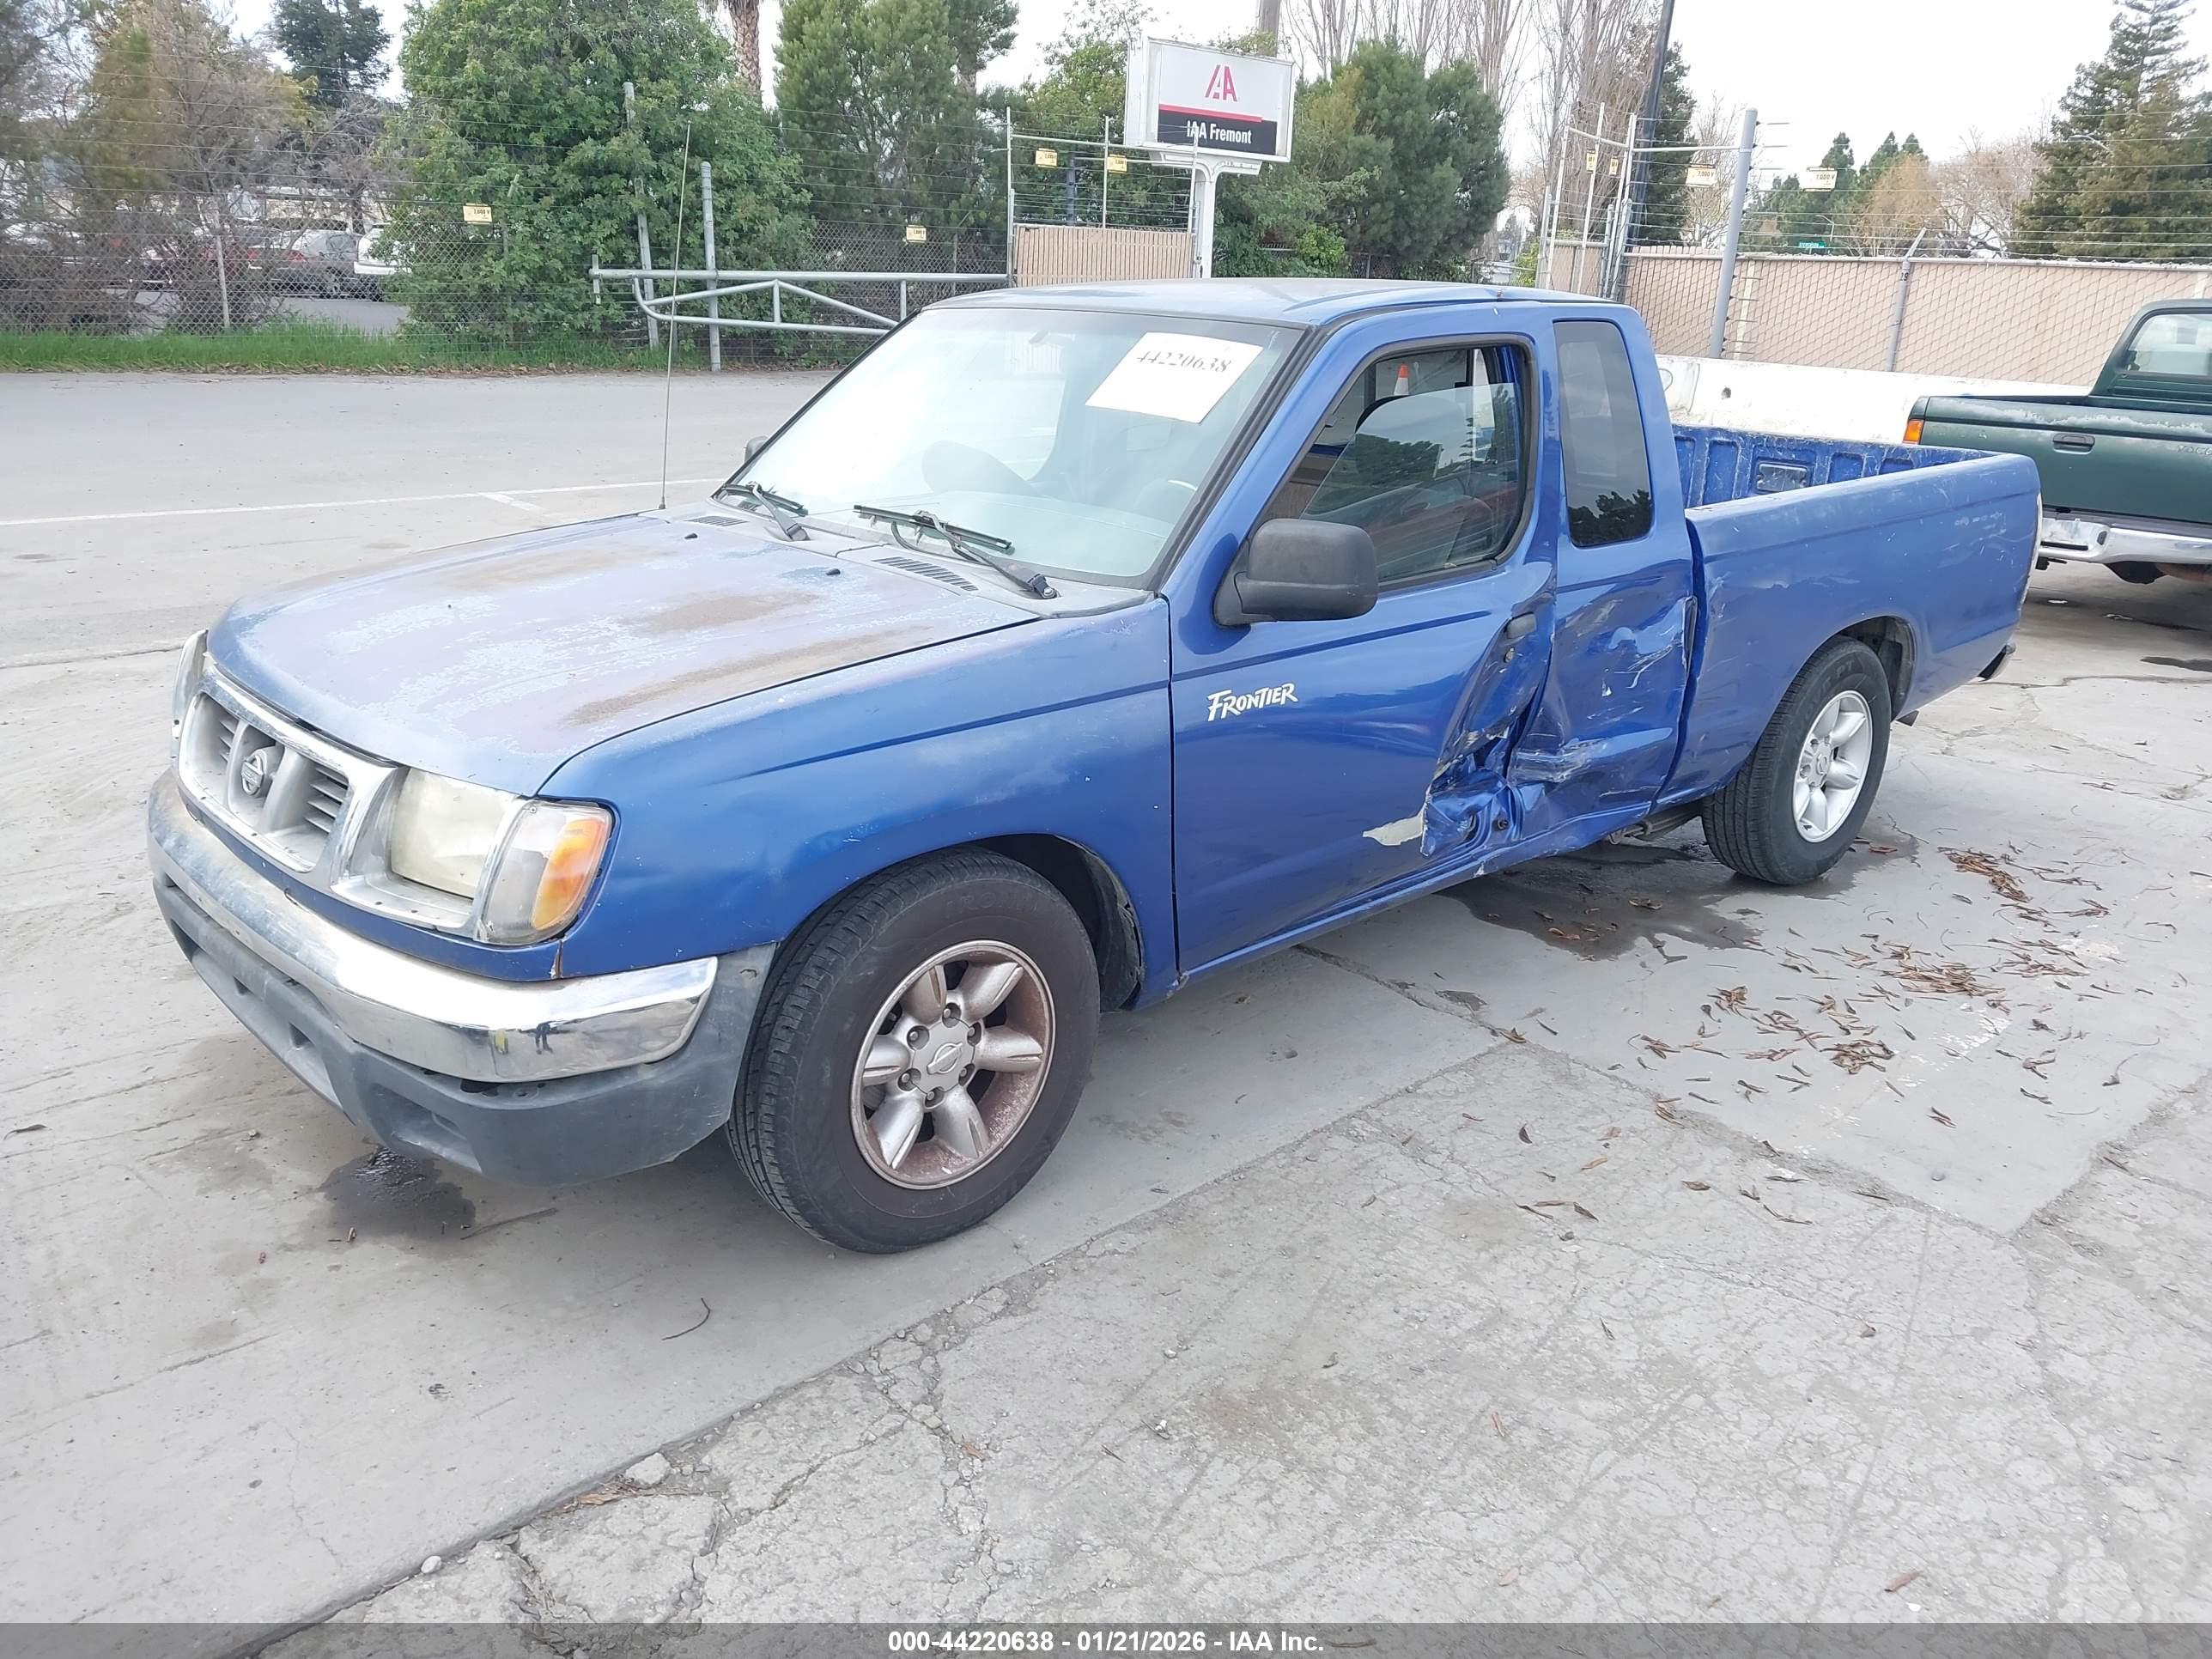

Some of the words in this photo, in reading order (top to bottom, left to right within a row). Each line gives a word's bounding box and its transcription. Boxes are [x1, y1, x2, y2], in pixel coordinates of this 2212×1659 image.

[1187, 120, 1206, 139] IAA
[1210, 123, 1252, 144] Fremont
[1137, 350, 1232, 373] 44220638
